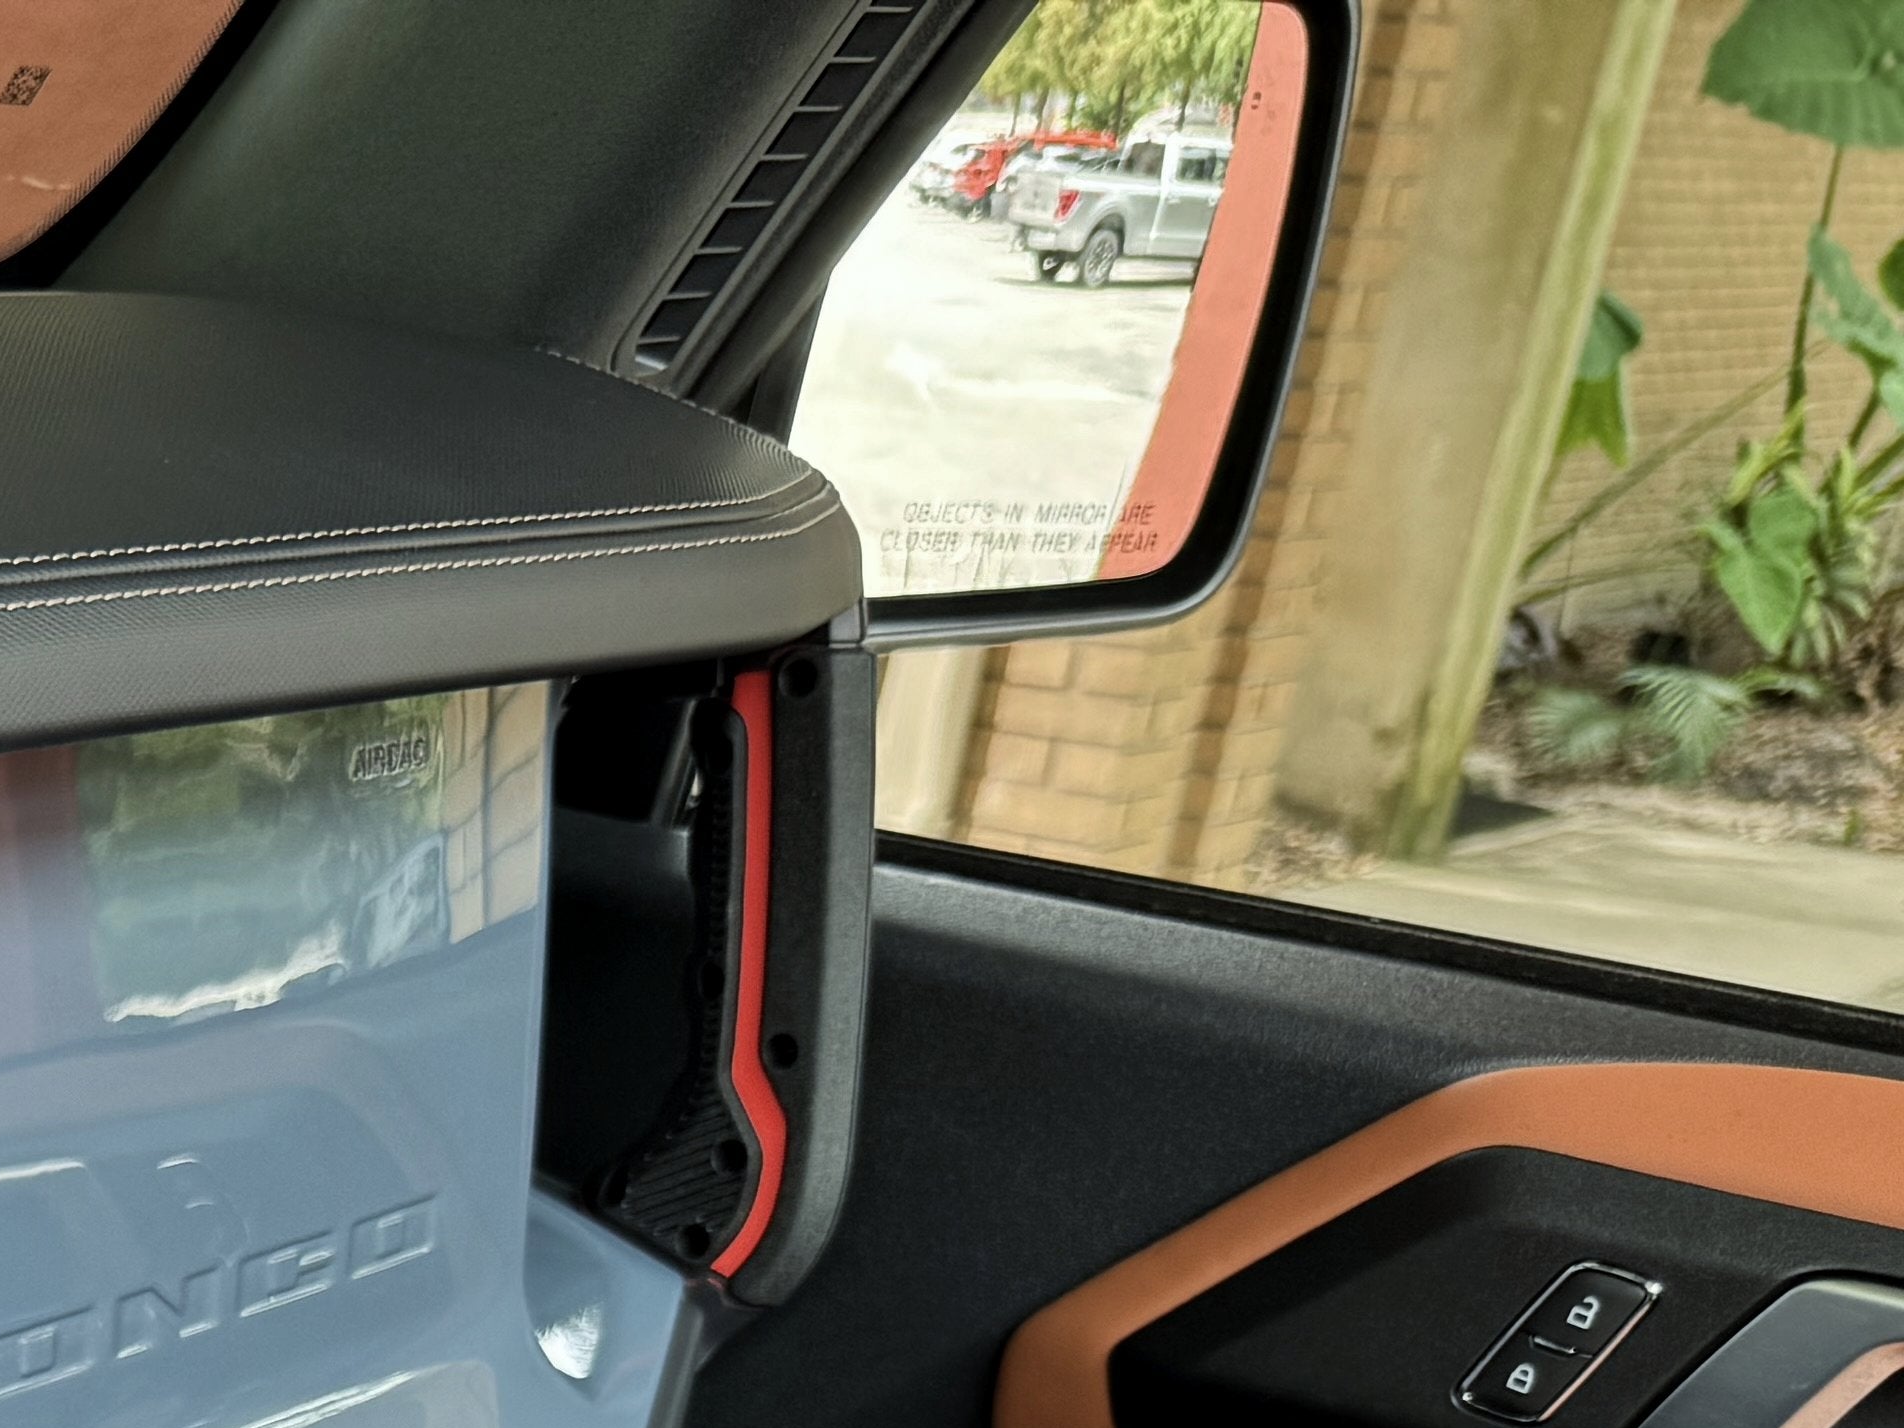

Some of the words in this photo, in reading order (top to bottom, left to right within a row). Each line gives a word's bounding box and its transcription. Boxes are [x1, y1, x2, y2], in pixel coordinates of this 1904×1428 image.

[902, 500, 993, 526] OBJECTS
[1004, 502, 1023, 526] IN
[1034, 502, 1107, 526] MIRROR
[1117, 502, 1156, 526] ARE
[880, 529, 958, 553] CLOSER
[970, 530, 1019, 553] THAN
[1030, 531, 1078, 553] THEY
[1085, 531, 1159, 553] APPEAR
[352, 737, 428, 780] AIRBAG
